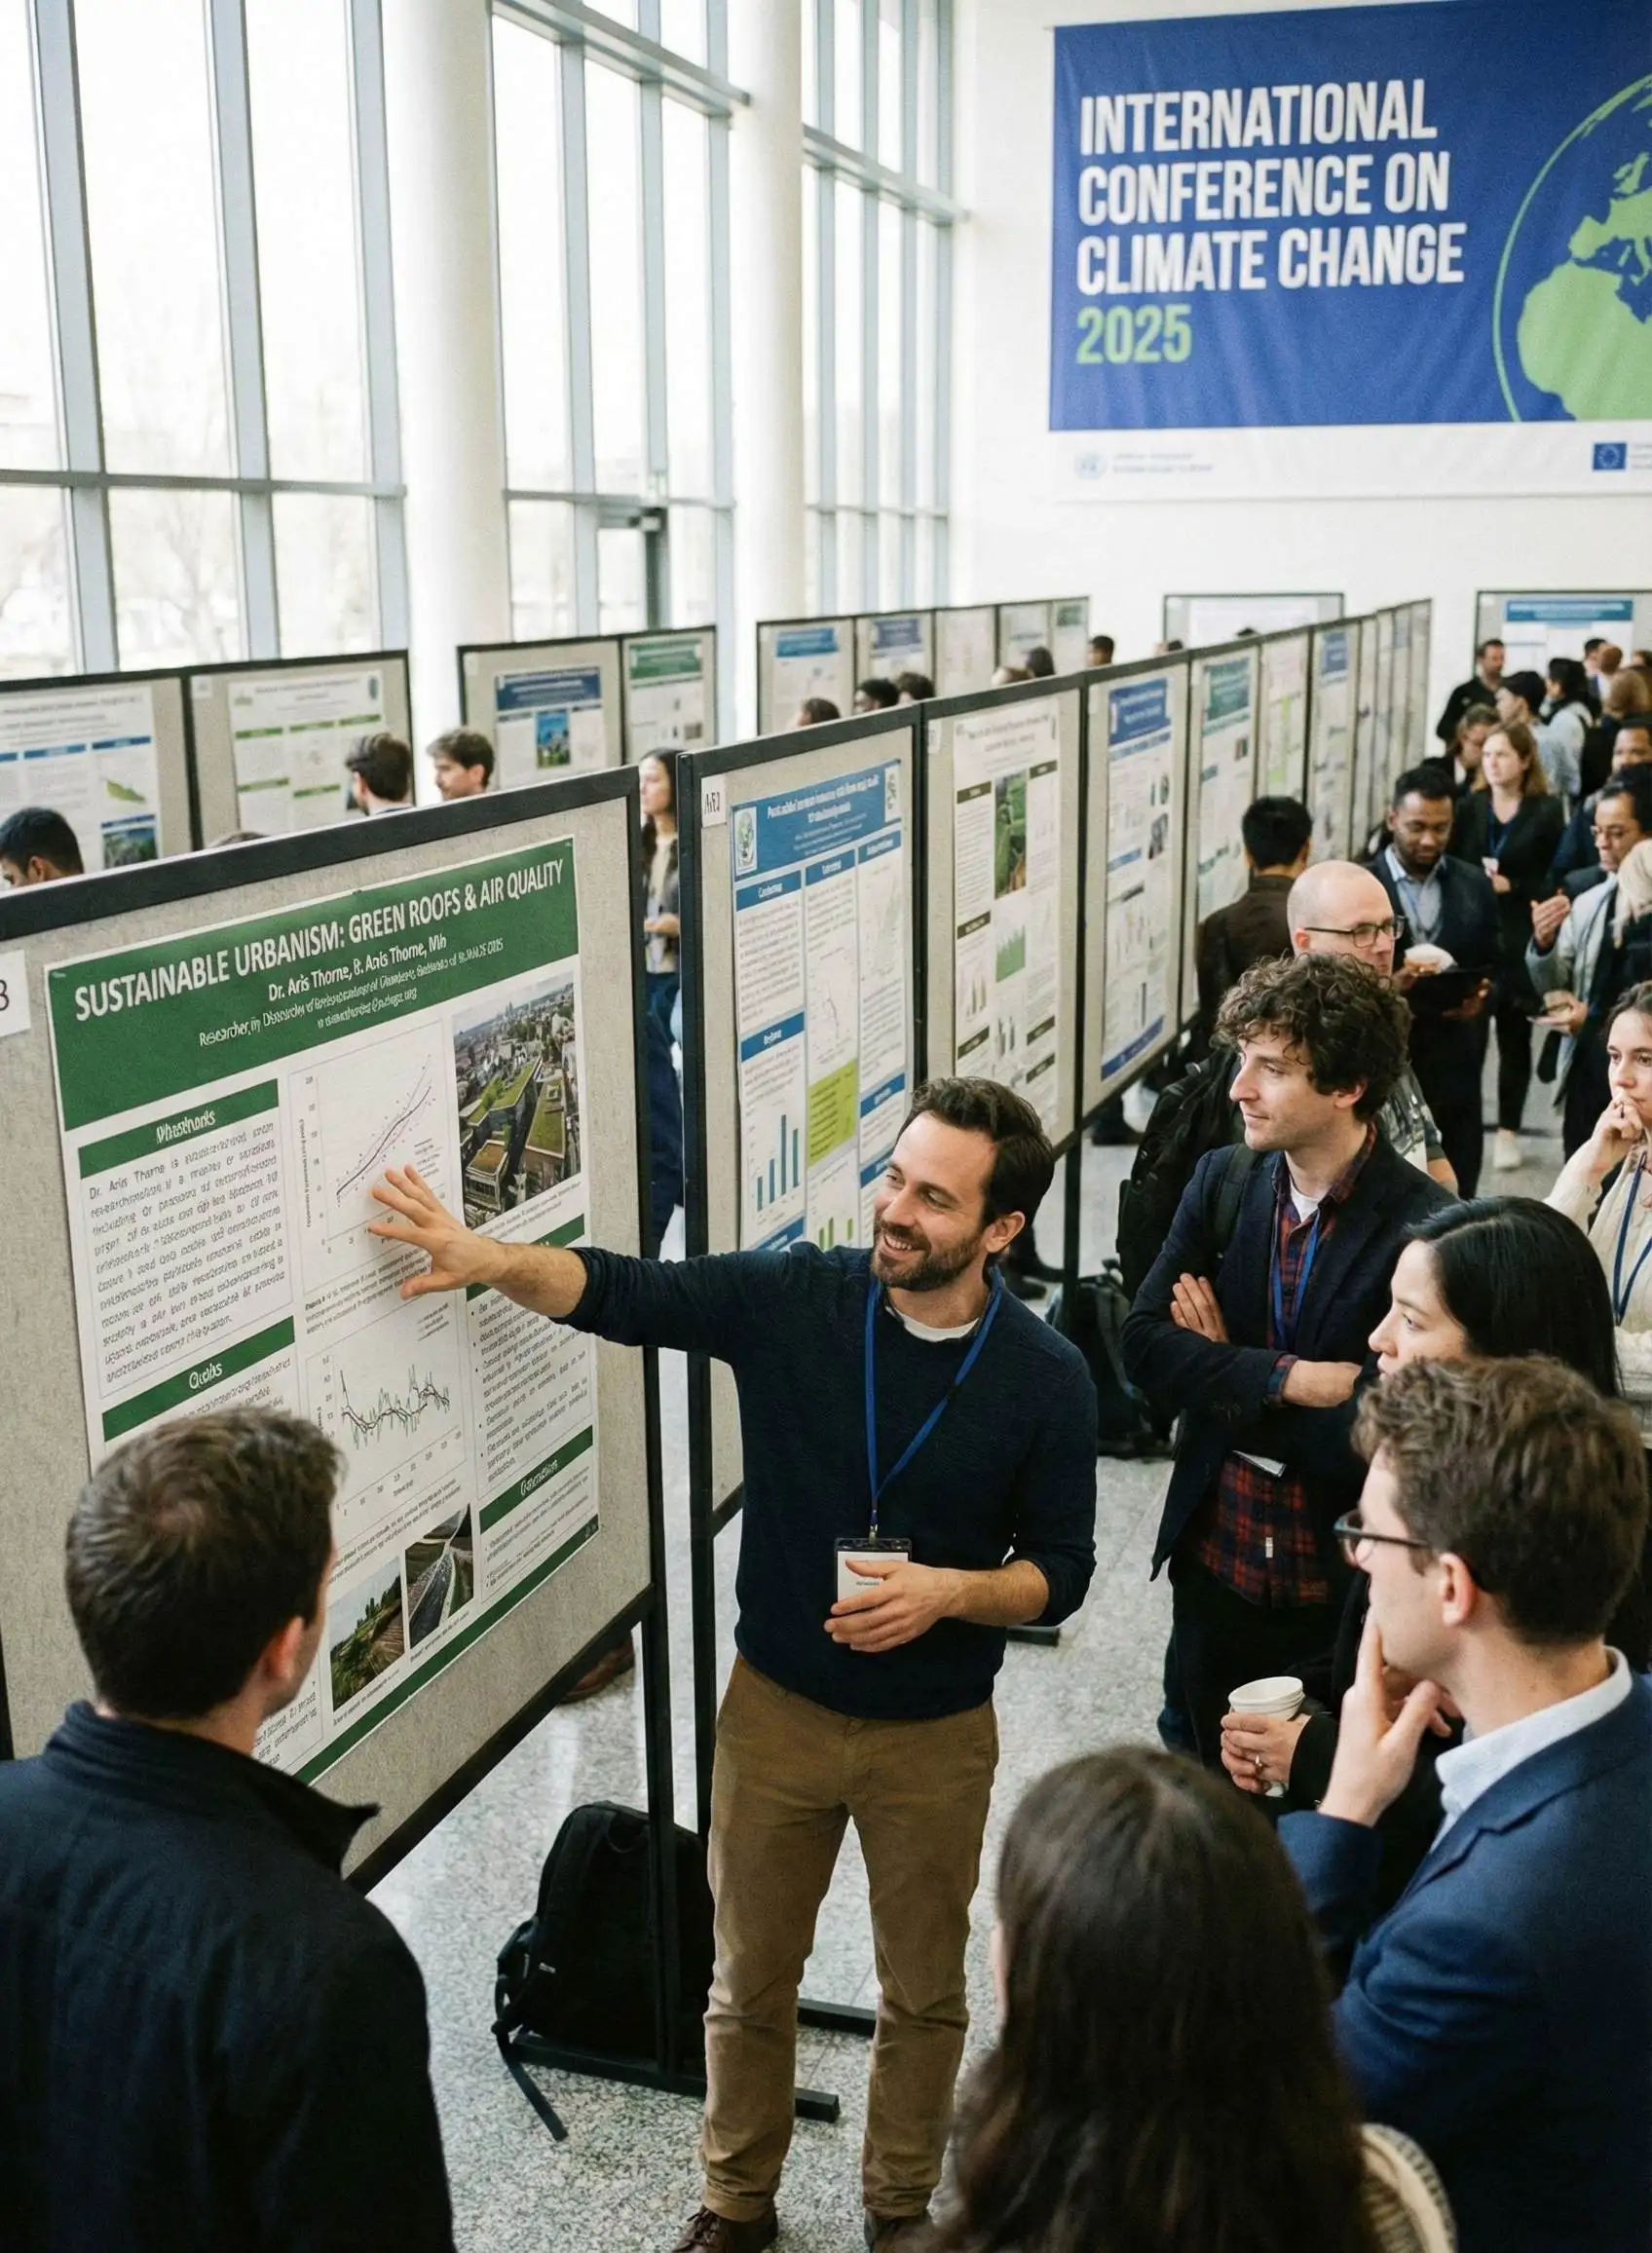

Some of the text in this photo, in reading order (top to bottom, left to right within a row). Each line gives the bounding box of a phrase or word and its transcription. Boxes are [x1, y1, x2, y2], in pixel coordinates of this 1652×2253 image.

[1080, 79, 1438, 156] INTERNATIONAL
[1078, 151, 1450, 226] CONFERENCE ON
[1076, 222, 1467, 295] CLIMATE CHANGE
[1076, 304, 1192, 365] 2025
[74, 950, 230, 1021] SUSTAINABLE
[235, 920, 345, 976] URBANISM:
[349, 903, 405, 944] GREEN
[409, 888, 462, 927] ROOFS
[465, 883, 477, 911] &
[480, 875, 505, 907] AIR
[507, 858, 565, 900] QUALITY
[269, 983, 285, 1001] Dr.
[311, 965, 353, 988] Thorne,
[389, 942, 428, 964] Thorne,
